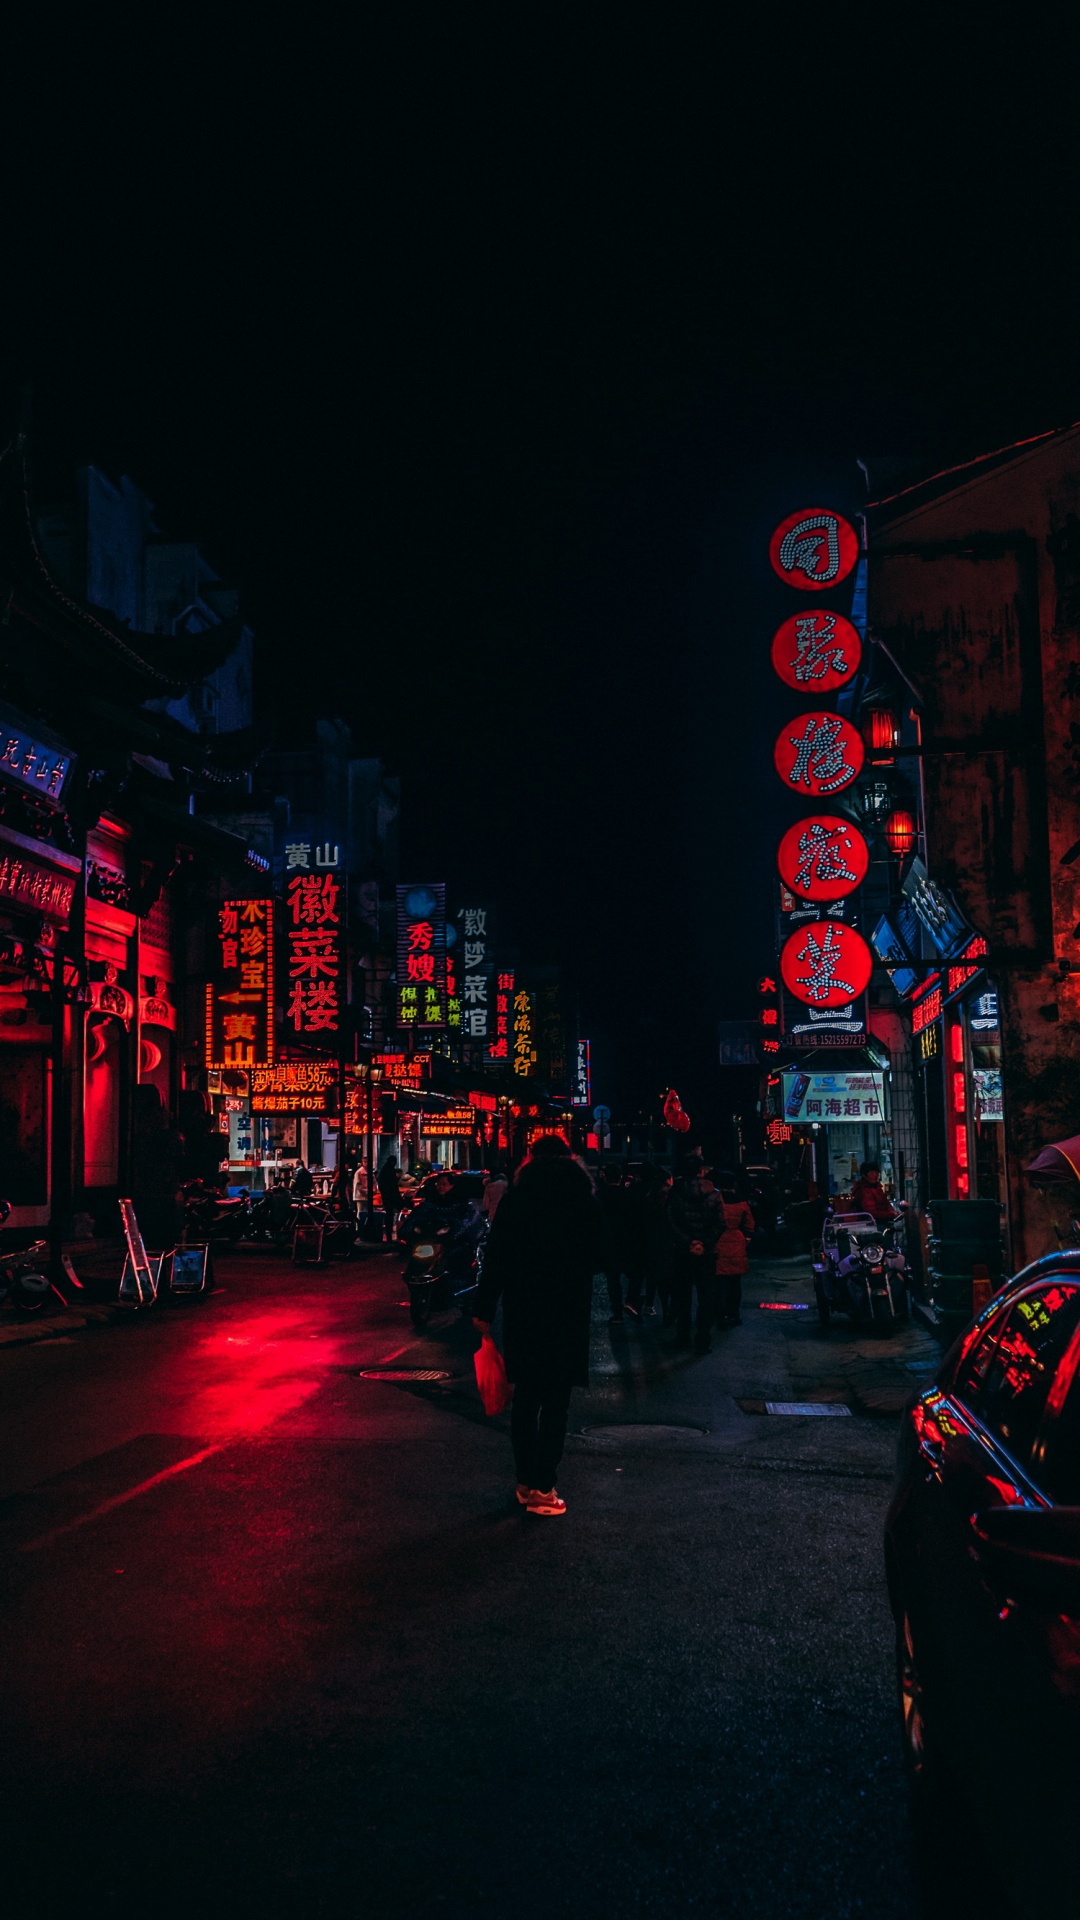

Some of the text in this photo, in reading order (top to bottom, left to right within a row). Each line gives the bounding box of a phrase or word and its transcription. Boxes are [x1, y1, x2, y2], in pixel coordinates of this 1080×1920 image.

[285, 842, 338, 869] 黄山
[286, 873, 340, 1032] 徽菜楼
[406, 921, 435, 983] 秀嫂
[223, 1013, 257, 1066] 黄山
[252, 1096, 326, 1111] 酱爆茄子10元
[806, 1098, 880, 1118] 阿海超市
